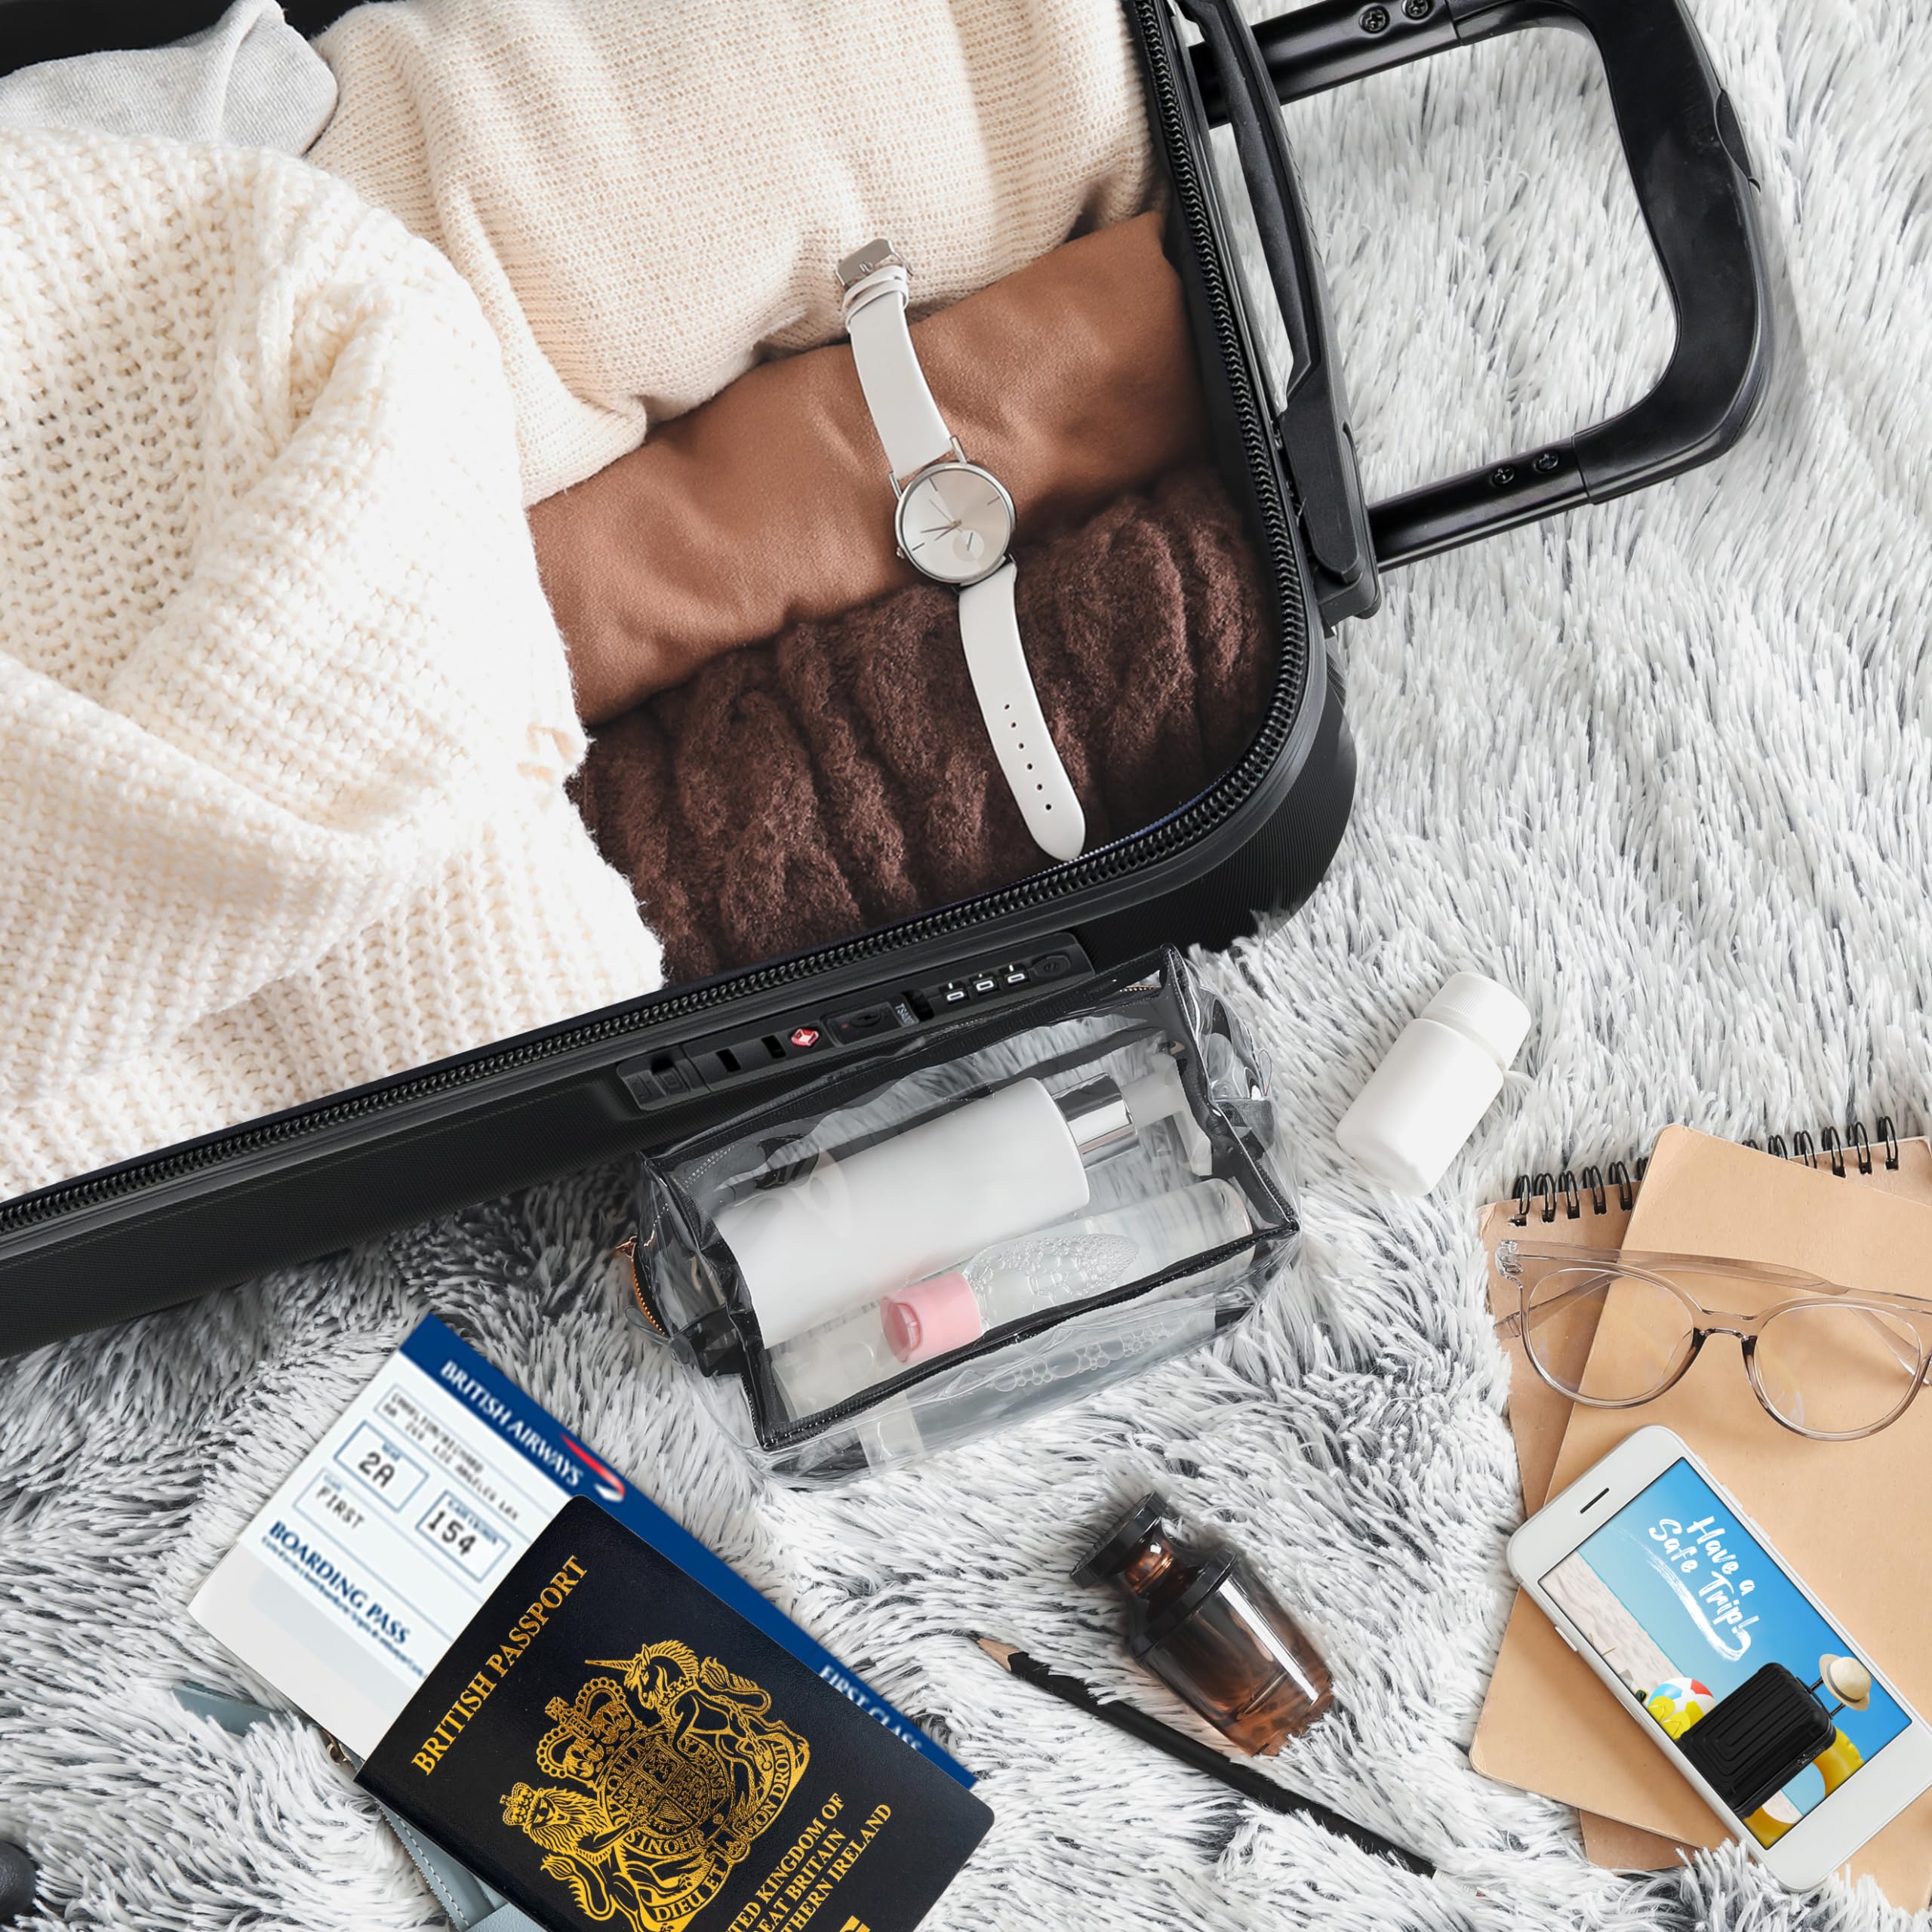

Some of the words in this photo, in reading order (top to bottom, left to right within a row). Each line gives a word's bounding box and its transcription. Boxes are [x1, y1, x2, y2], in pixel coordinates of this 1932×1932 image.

[358, 1451, 395, 1487] 2A
[441, 1360, 512, 1426] BRITISH
[506, 1420, 584, 1487] AIRWAYS
[315, 1486, 365, 1530] FIRST
[427, 1510, 476, 1555] 154
[1686, 1515, 1739, 1575] Have
[1739, 1580, 1755, 1596] a
[269, 1521, 368, 1609] BOARDING
[366, 1603, 411, 1644] PASS
[1648, 1518, 1698, 1573] Safe
[1699, 1571, 1760, 1635] Trip!
[411, 1672, 497, 1775] BRITISH
[485, 1555, 588, 1678] PASSPORT
[652, 1894, 706, 1922] DIEU
[702, 1865, 728, 1893] ET
[739, 1799, 778, 1836] MON
[769, 1743, 790, 1800] DROIT
[726, 1902, 761, 1932] TED
[755, 1817, 827, 1904] KINGDOM
[821, 1792, 844, 1820] OF
[755, 1897, 790, 1932] EAT
[784, 1828, 846, 1902] BRITAIN
[780, 1878, 834, 1932] THERN
[827, 1804, 892, 1882] IRELAND
